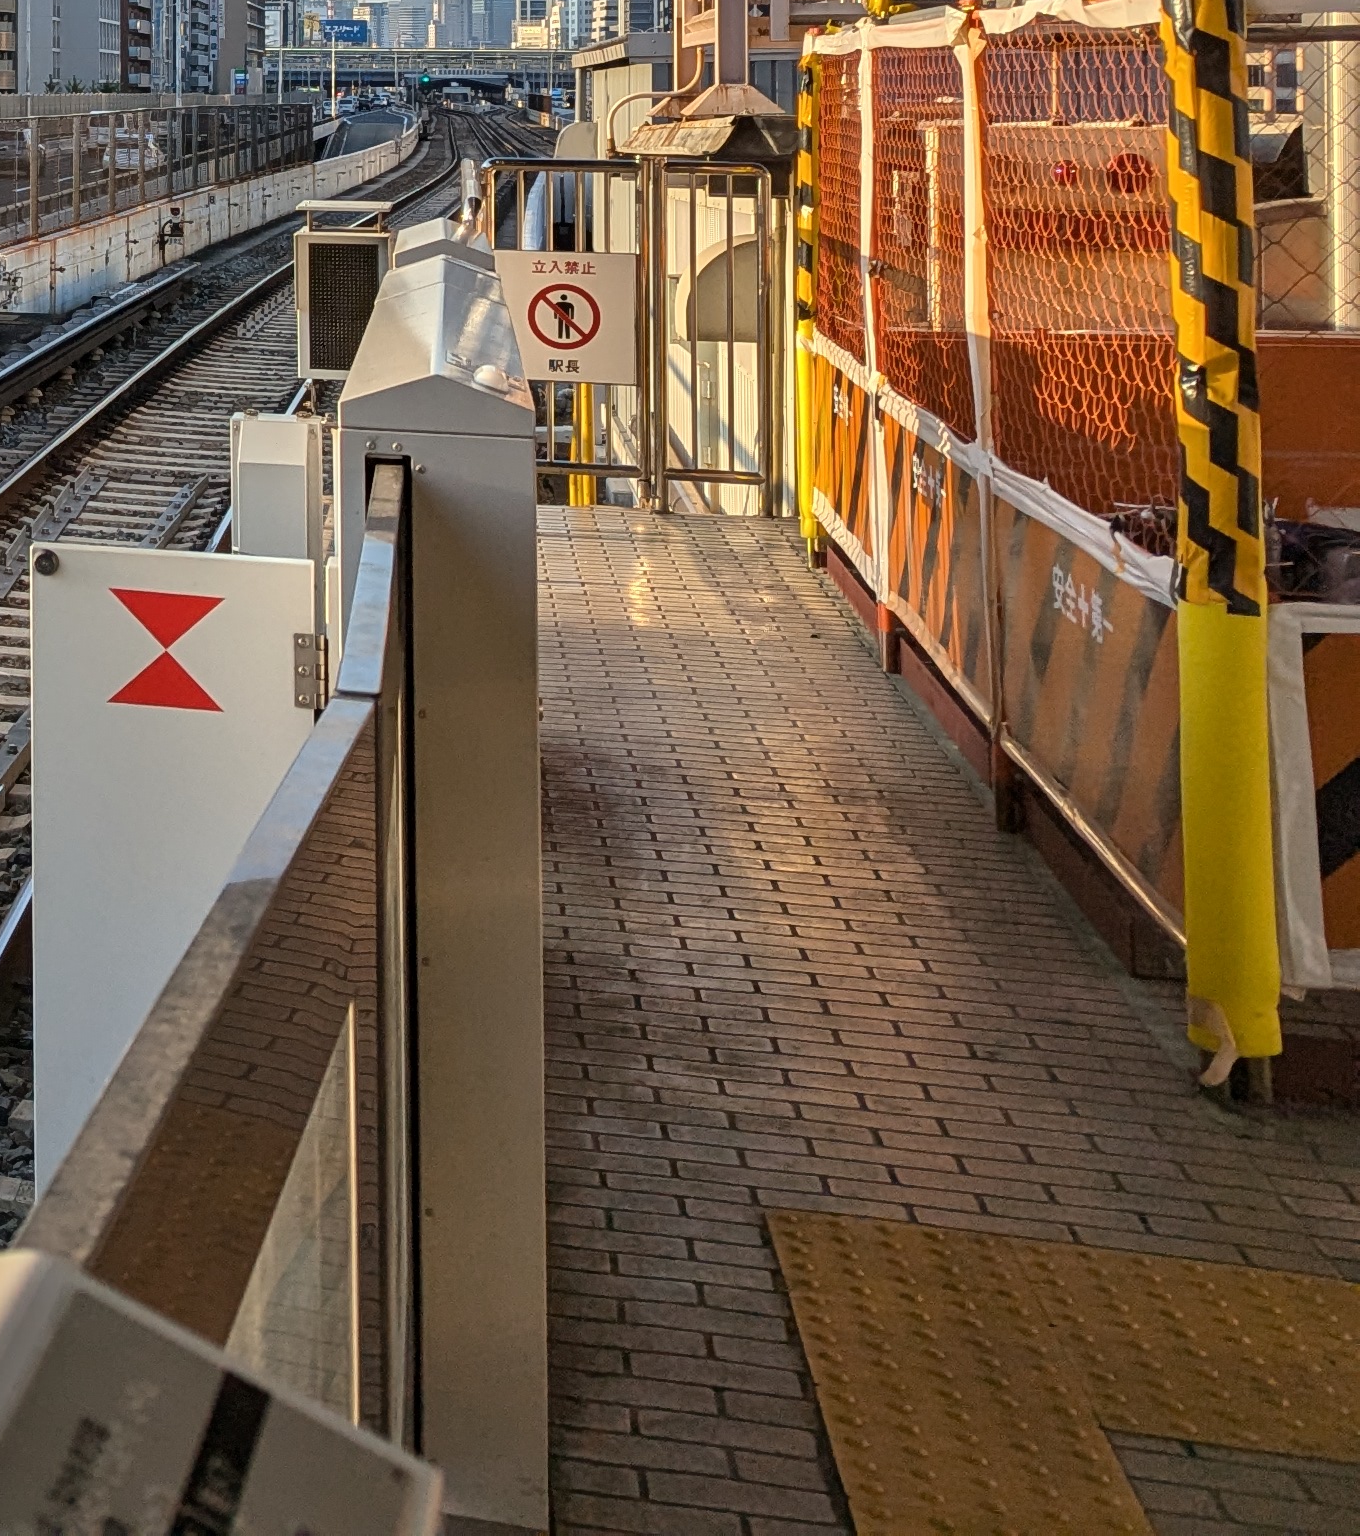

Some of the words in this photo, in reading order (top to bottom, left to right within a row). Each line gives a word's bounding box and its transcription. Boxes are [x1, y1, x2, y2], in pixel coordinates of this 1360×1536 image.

[531, 259, 597, 276] 立入禁止
[548, 359, 580, 374] 駅長
